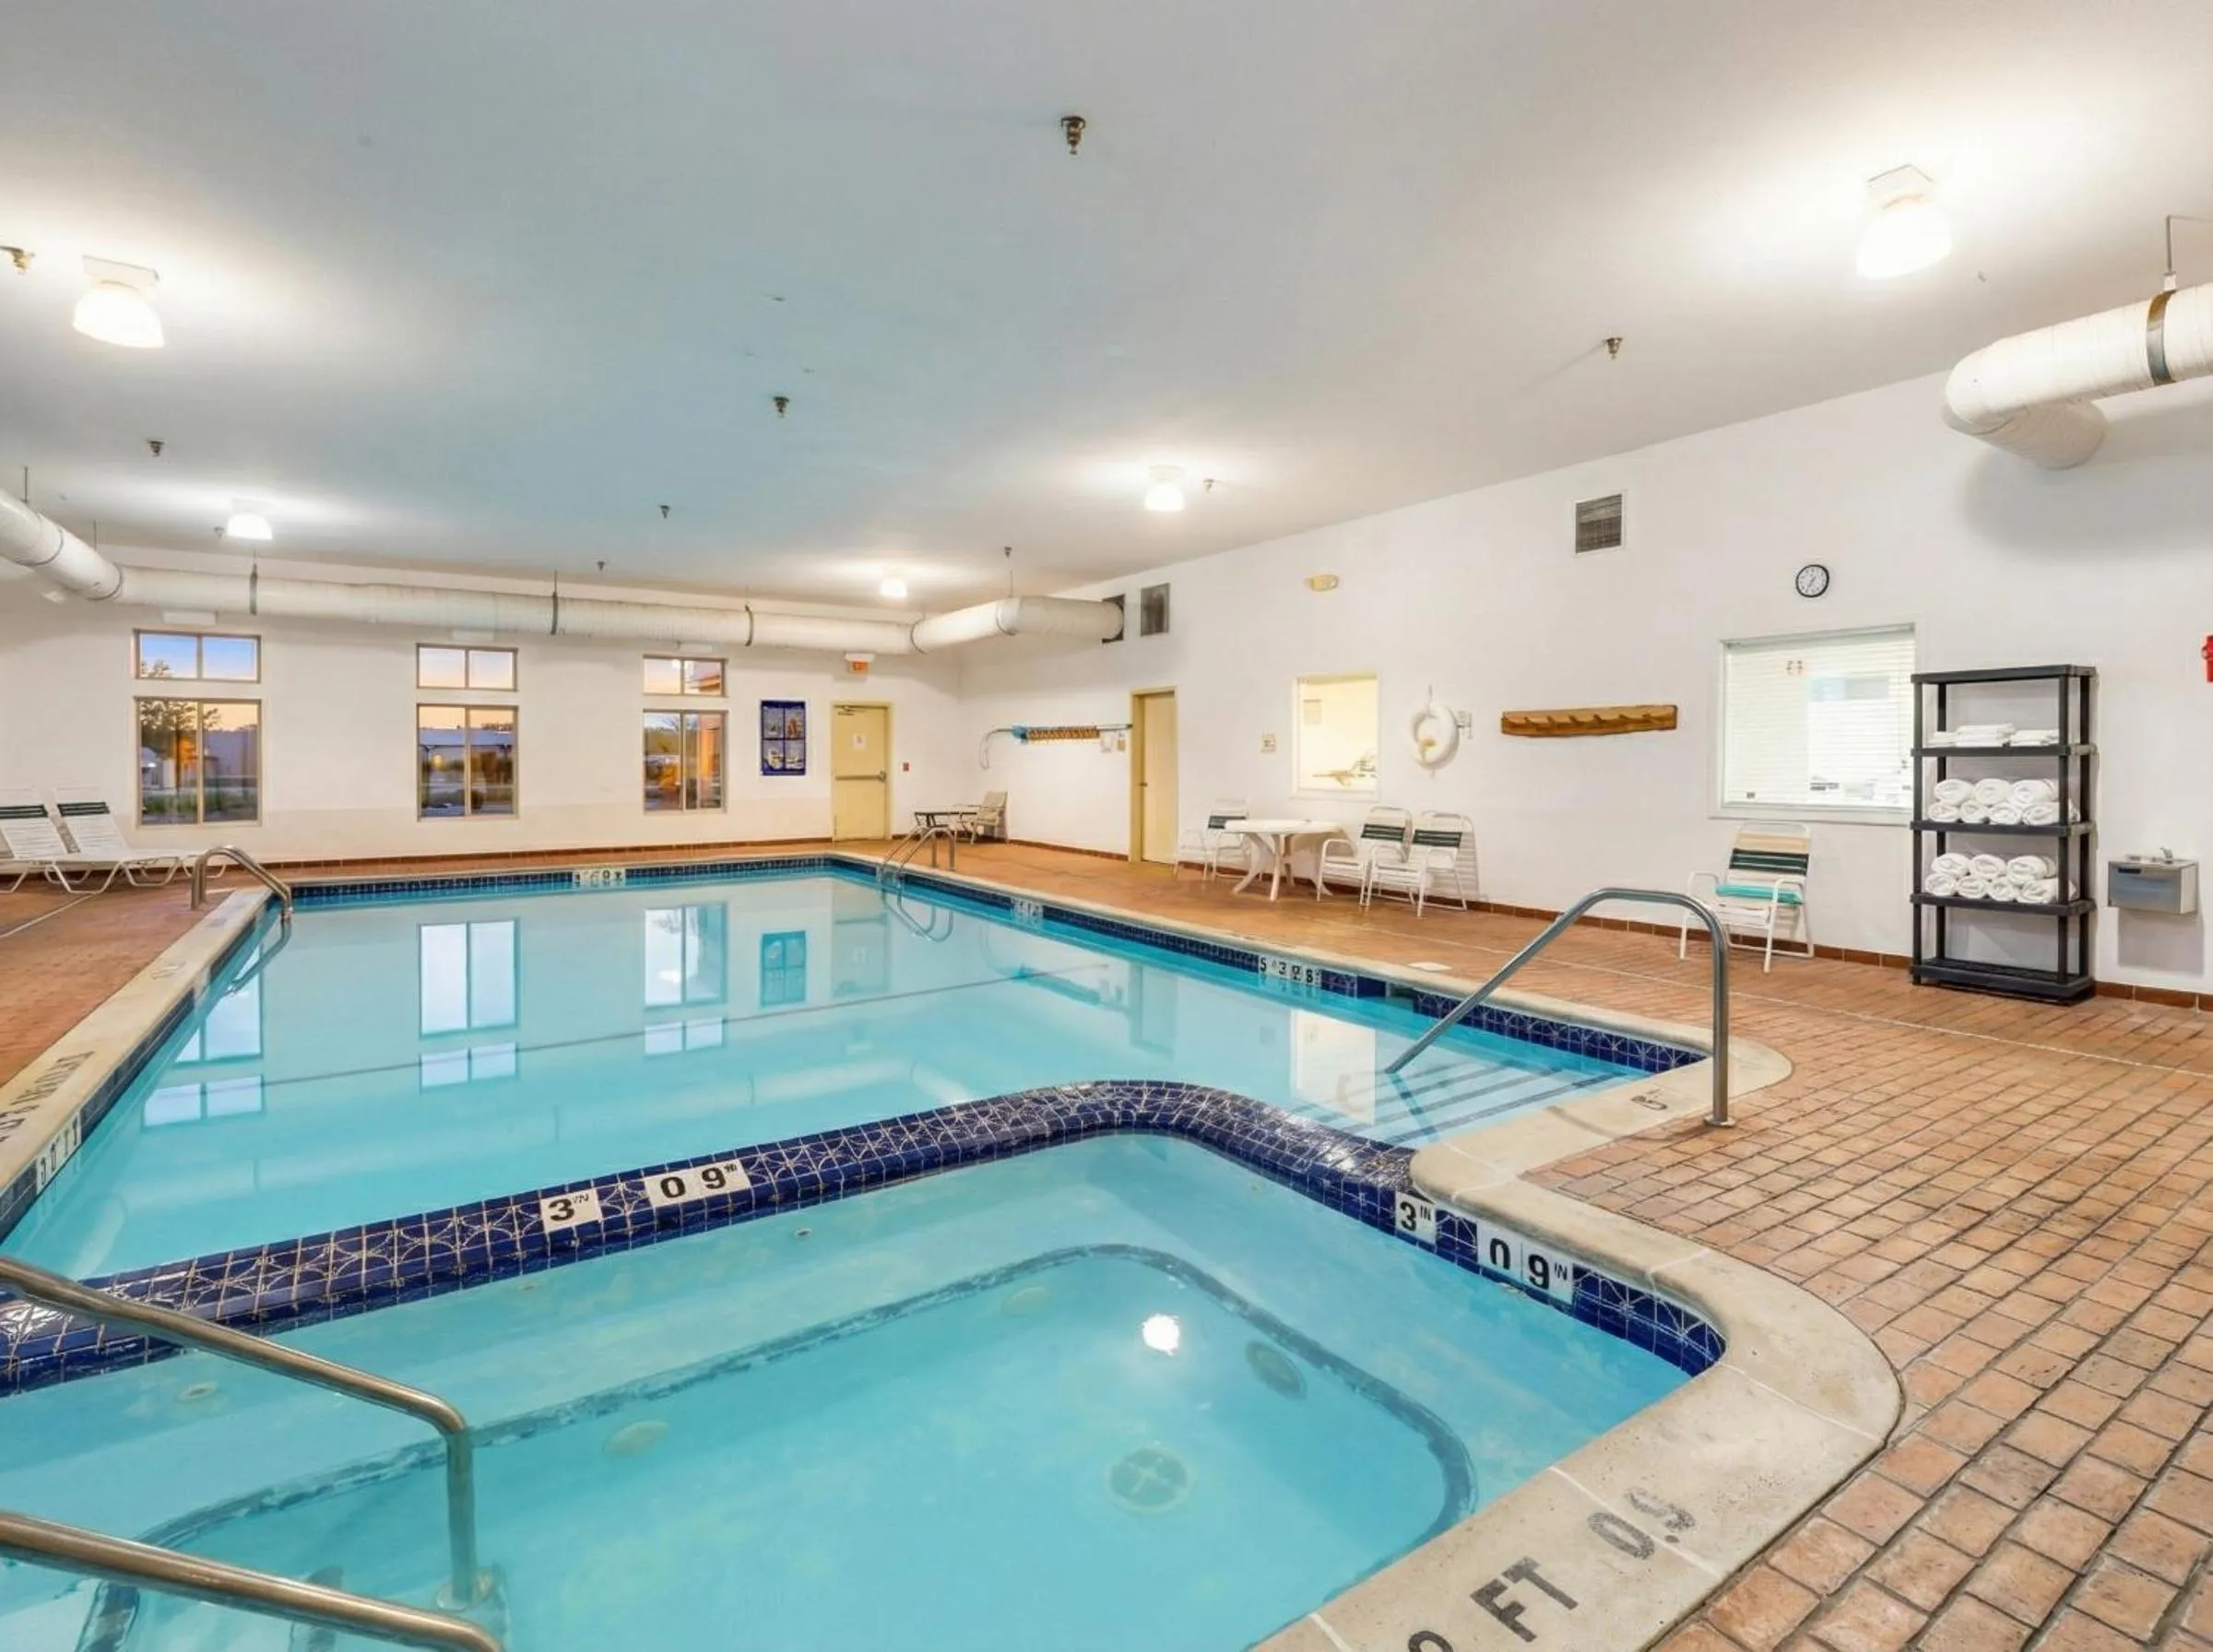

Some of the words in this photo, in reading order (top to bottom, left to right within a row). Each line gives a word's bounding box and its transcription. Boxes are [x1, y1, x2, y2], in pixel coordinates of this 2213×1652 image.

[549, 1198, 575, 1221] 3
[1400, 1201, 1417, 1232] 3
[1470, 1556, 1579, 1643] FT
